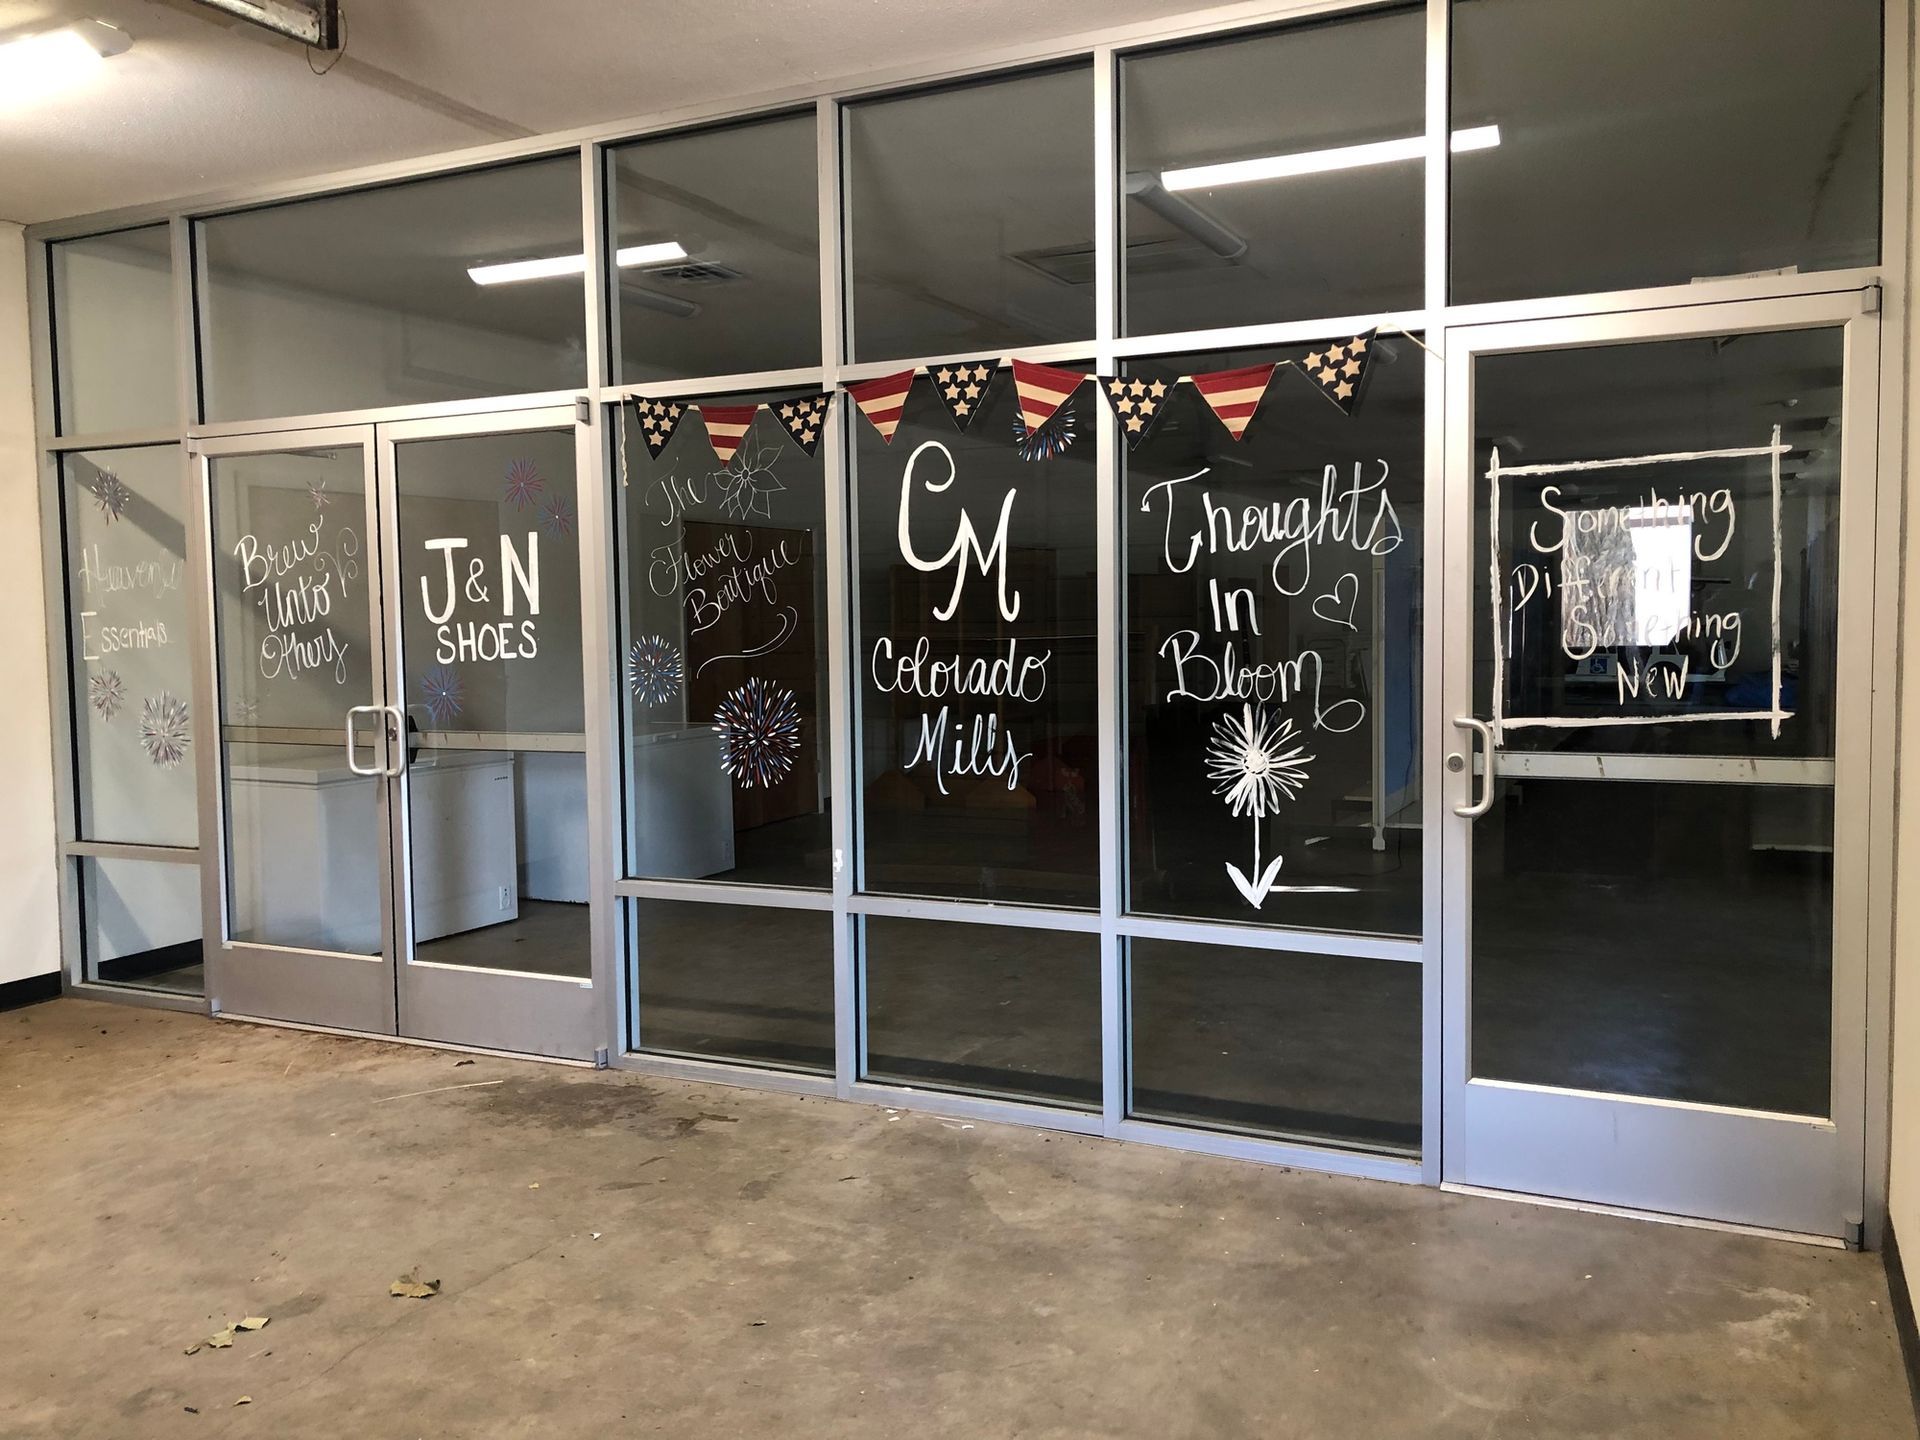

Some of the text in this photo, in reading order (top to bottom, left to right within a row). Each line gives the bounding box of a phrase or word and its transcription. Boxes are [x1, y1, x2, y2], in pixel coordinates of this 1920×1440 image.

[645, 457, 711, 526] The
[1530, 485, 1736, 561] Something
[234, 515, 323, 593] Brew
[649, 527, 753, 597] Flower
[898, 440, 1020, 622] CM
[1141, 459, 1403, 595] Thoughts
[258, 573, 330, 632] Unto
[421, 532, 539, 624] J & N
[683, 540, 802, 635] Boutique
[1209, 578, 1262, 635] In
[80, 611, 168, 660] Essentials
[260, 628, 348, 684] Others
[436, 620, 538, 664] SHOES
[872, 637, 1051, 702] Colorado
[1563, 605, 1741, 669] Soething
[1159, 630, 1366, 732] Bloom
[904, 705, 1033, 795] Mills
